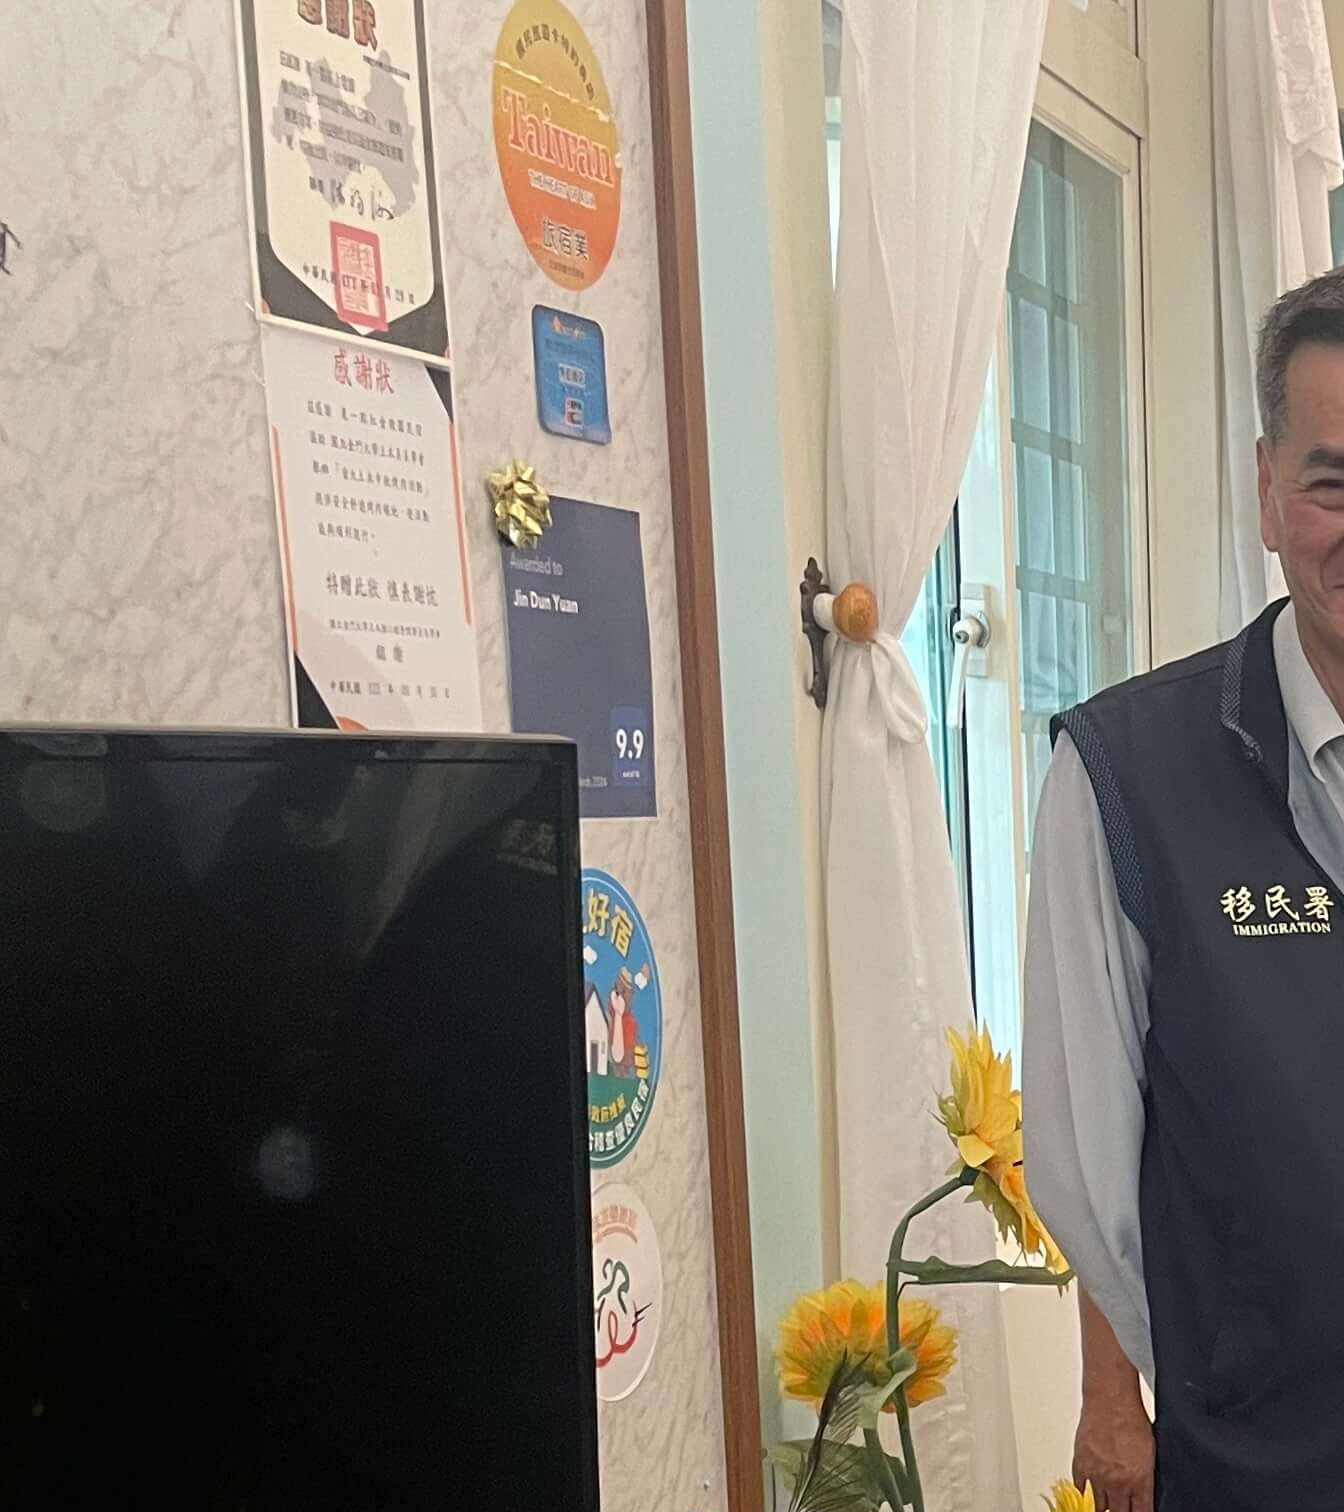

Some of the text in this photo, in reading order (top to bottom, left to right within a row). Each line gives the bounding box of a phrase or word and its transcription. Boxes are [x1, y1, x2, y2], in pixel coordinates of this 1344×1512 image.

[501, 85, 616, 189] Taiwan
[333, 348, 395, 394] 感謝狀
[510, 552, 564, 576] Awarded to
[326, 571, 381, 599] 特贈此狀
[513, 589, 579, 614] Jin Dun Yuan
[615, 728, 645, 760] 9.9
[1219, 885, 1335, 922] 移民署
[583, 887, 634, 958] 好宿
[1232, 921, 1332, 937] IMMIGRATION
